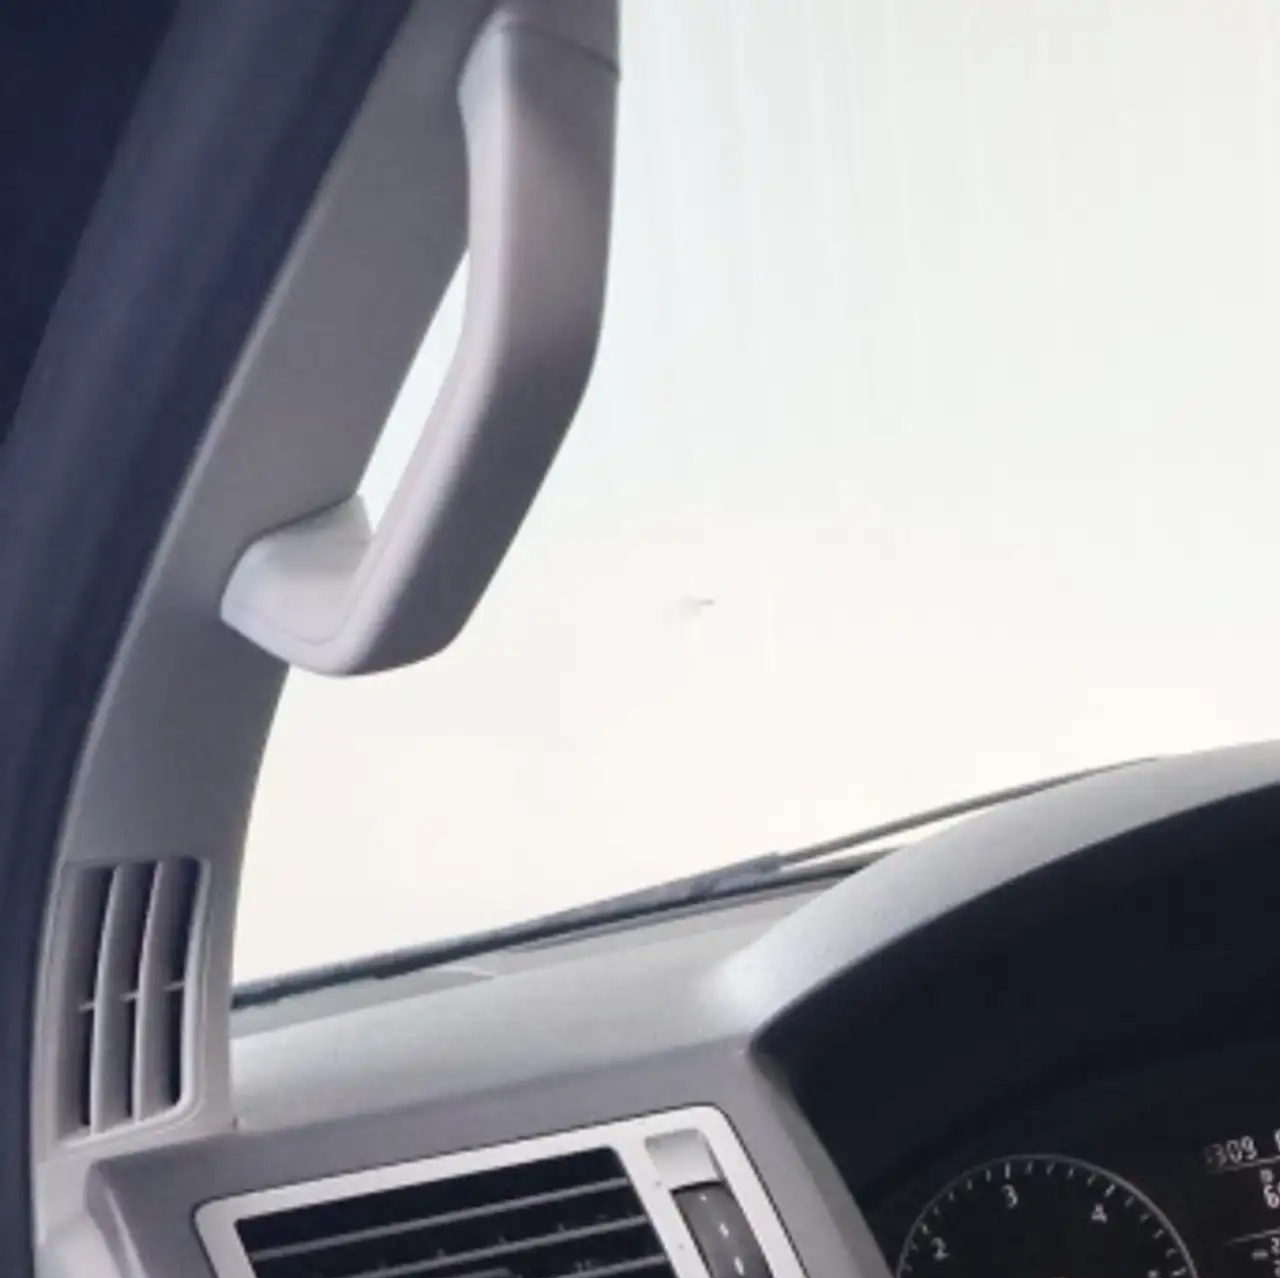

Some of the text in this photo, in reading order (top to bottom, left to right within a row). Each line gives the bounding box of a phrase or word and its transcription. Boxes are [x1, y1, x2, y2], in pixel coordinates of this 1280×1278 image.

[1002, 1184, 1018, 1209] 3
[1091, 1203, 1108, 1224] 4
[930, 1236, 950, 1261] 2
